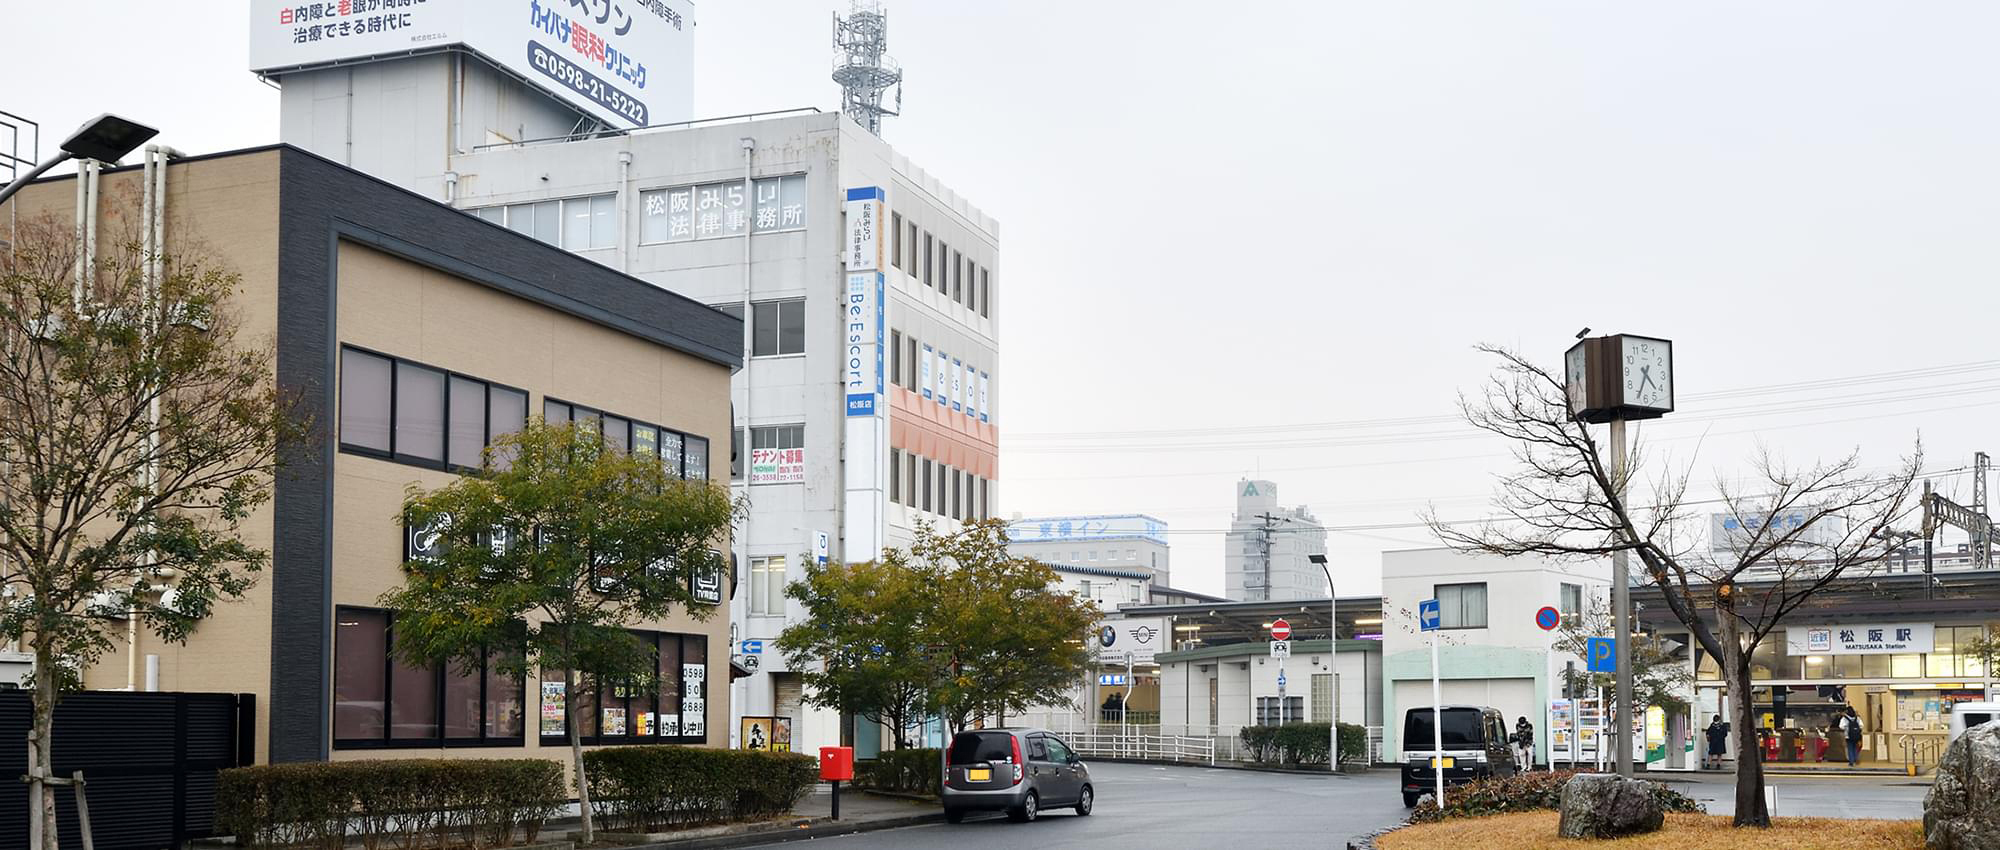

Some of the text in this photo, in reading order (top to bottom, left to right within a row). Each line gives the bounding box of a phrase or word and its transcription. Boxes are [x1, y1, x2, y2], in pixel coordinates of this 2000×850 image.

[293, 13, 411, 44] 治療できる時代に
[548, 52, 644, 124] 0598-21-5222
[670, 204, 802, 237] 法律事務所
[1632, 346, 1639, 355] 11
[1641, 344, 1648, 353] 12
[1651, 348, 1655, 357] 1
[1626, 355, 1634, 365] 10
[1657, 357, 1663, 366] 2
[1625, 367, 1630, 376] 9
[1660, 371, 1666, 380] 3
[1627, 380, 1633, 389] 8
[1658, 384, 1663, 392] 4
[1643, 394, 1649, 403] 6
[1651, 392, 1657, 401] 5
[1039, 520, 1110, 538] 東横イン
[1839, 628, 1912, 643] 松阪駅
[1595, 640, 1611, 669] P
[683, 667, 704, 678] 0598
[687, 685, 699, 695] 50
[682, 702, 704, 712] 2688
